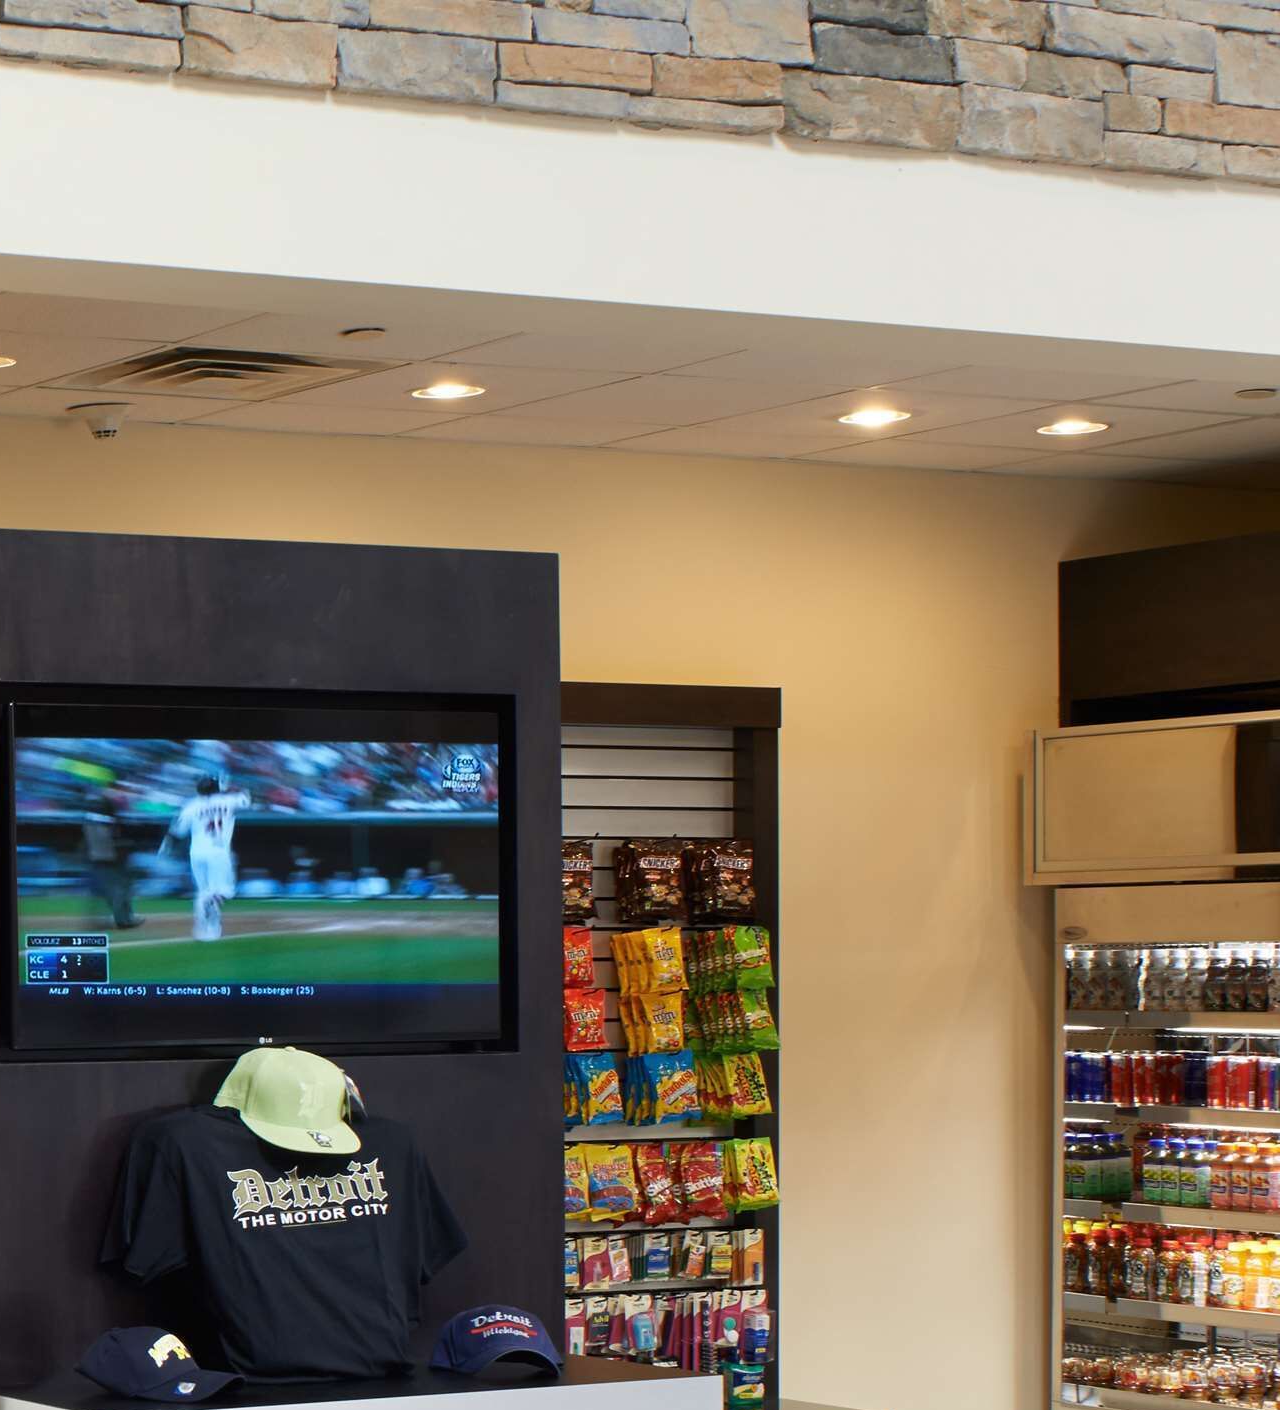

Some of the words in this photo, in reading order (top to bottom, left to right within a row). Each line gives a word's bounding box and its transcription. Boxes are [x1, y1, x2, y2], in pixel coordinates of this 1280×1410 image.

[456, 758, 474, 766] FOX
[451, 772, 481, 782] TIGERS
[71, 938, 82, 946] 13
[82, 938, 105, 946] PITCHES
[29, 956, 45, 964] KC
[60, 955, 68, 964] 4
[29, 970, 50, 979] CLE
[61, 970, 67, 979] 1
[83, 986, 95, 995] W:
[97, 986, 122, 995] Karns
[123, 986, 147, 996] (6-5)
[156, 987, 165, 995] L:
[167, 986, 202, 996] Sanchez
[204, 986, 231, 996] (10-8)
[241, 987, 249, 996] S:
[251, 986, 294, 996] Boxberger
[296, 986, 315, 996] (25)
[227, 1158, 389, 1220] Detroit
[237, 1214, 277, 1229] THE
[280, 1208, 347, 1225] MOTOR
[351, 1204, 389, 1217] CITY
[470, 1311, 533, 1328] Detroit
